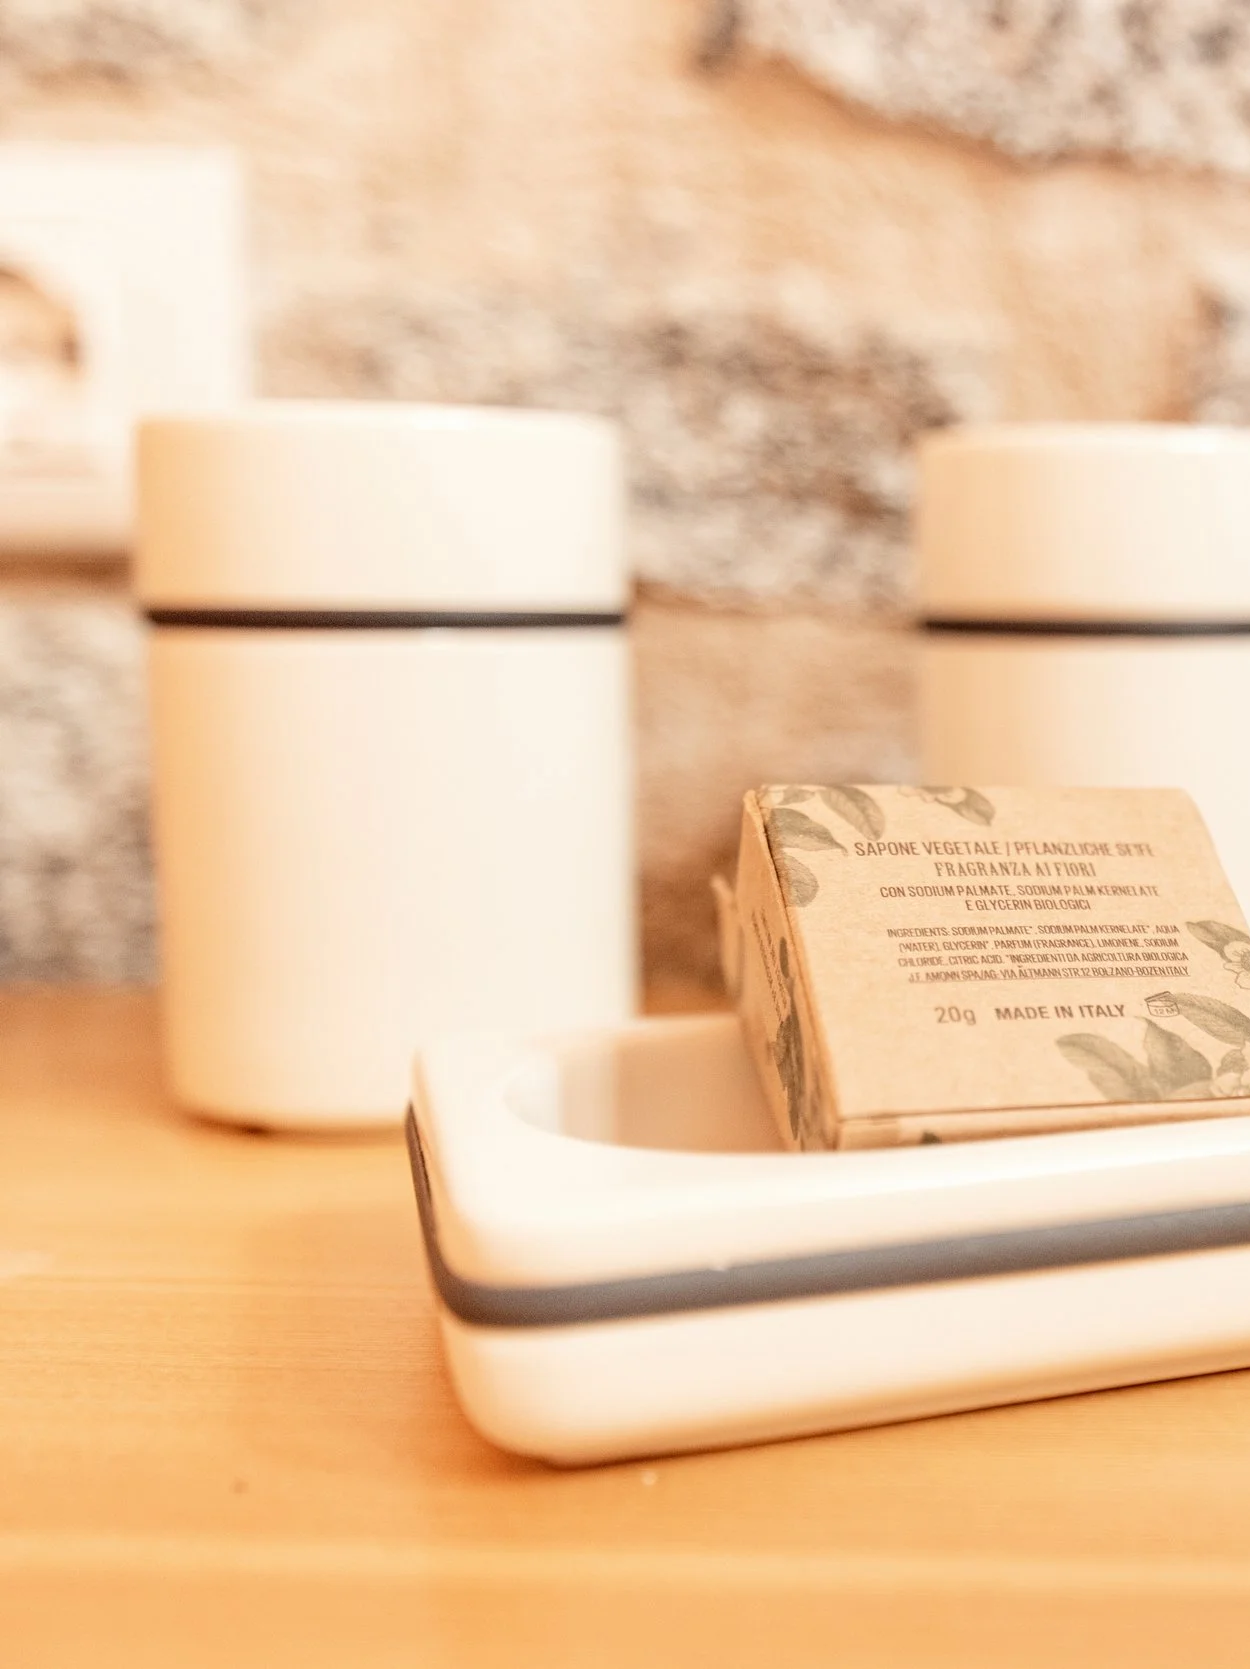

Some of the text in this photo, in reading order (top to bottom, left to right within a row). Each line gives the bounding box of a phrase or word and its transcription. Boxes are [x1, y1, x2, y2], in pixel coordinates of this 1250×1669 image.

[854, 841, 920, 857] SAPONE
[921, 840, 1004, 856] VEGETALE
[1013, 841, 1114, 857] PFLANZLICHE
[934, 861, 1097, 877] FRAGRANZA AI FIORI
[880, 886, 907, 898] CON
[908, 885, 956, 898] SODIUM
[1016, 884, 1063, 897] SODIUM
[1063, 884, 1096, 897] PALM
[1097, 885, 1160, 897] KERNELATE
[965, 899, 1092, 911] E GLYCERIN BIOLOGICI
[951, 926, 988, 936] SODIUM
[1038, 925, 1074, 935] SODIUM
[1074, 925, 1099, 934] PALM
[1155, 924, 1181, 934] AQUA
[993, 939, 1033, 950] PARFUM
[1144, 938, 1179, 948] SODIUM
[949, 955, 980, 966] CITRIC
[1081, 952, 1142, 963] AGRICOLTURA
[1142, 952, 1189, 962] BIOLOGICA
[933, 1004, 1125, 1026] 20g MADE IN ITALY
